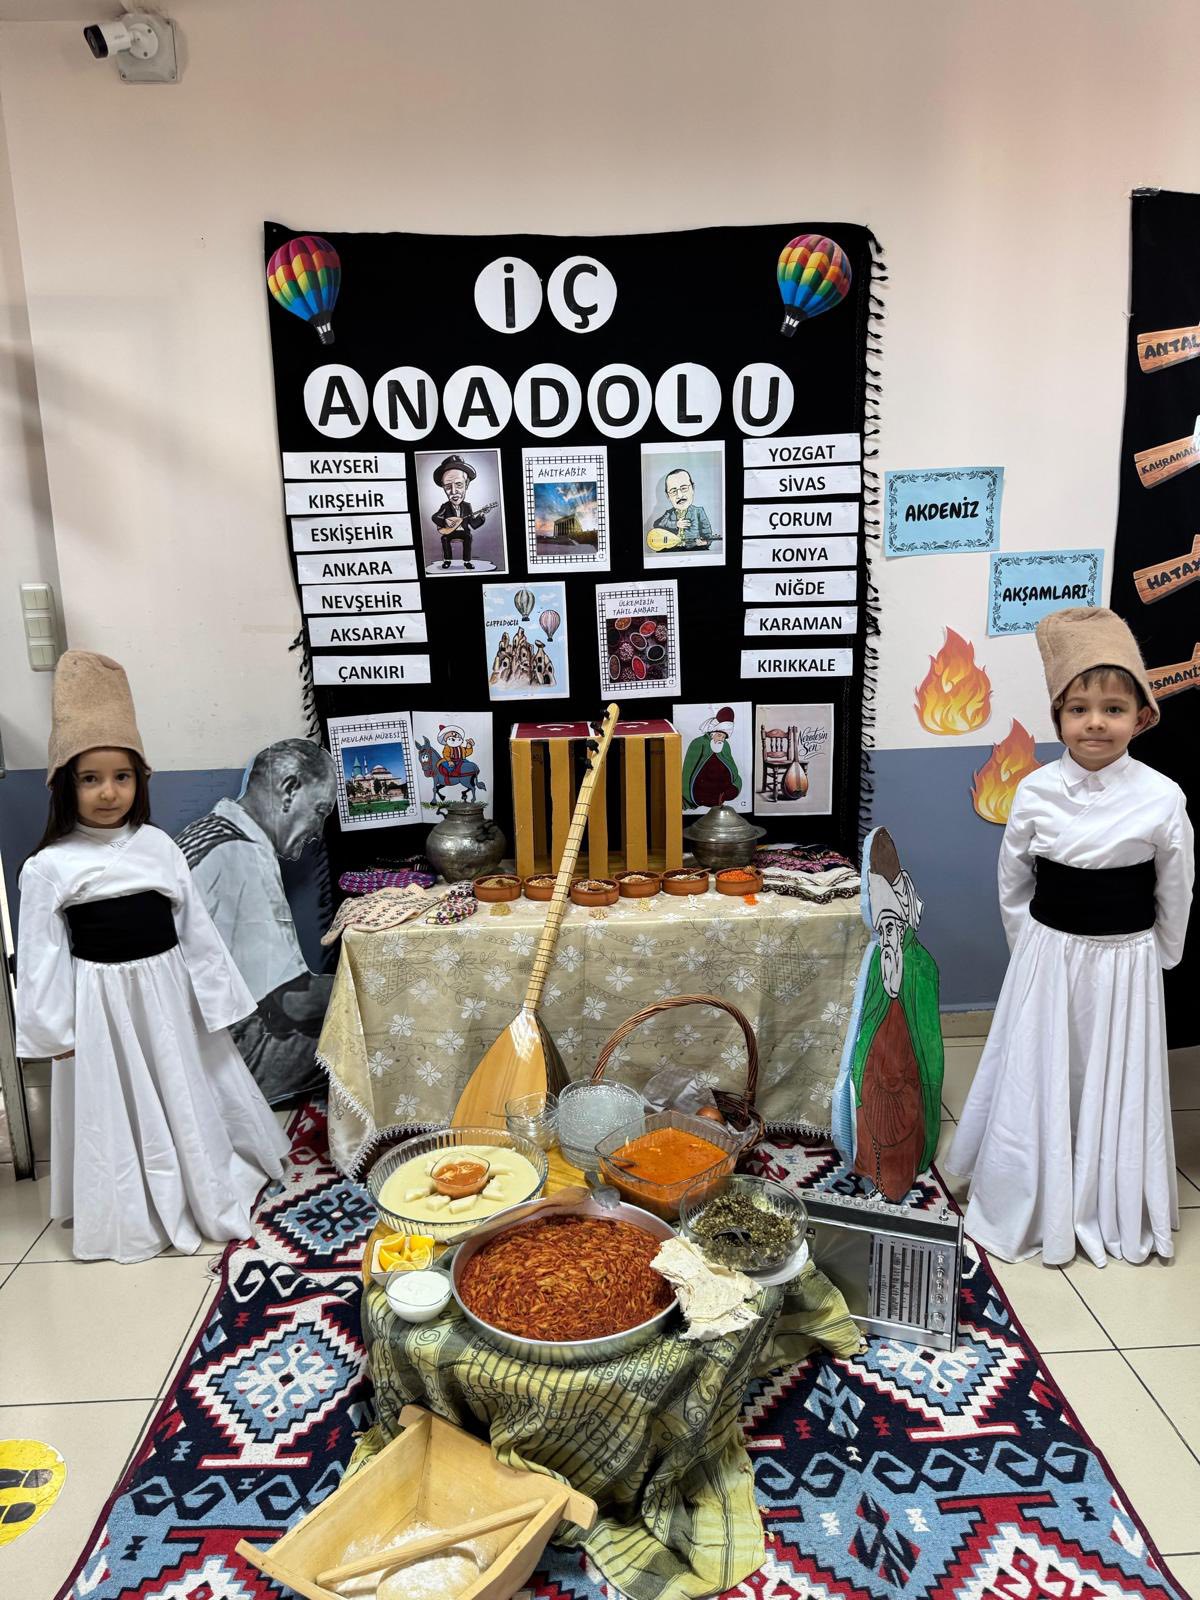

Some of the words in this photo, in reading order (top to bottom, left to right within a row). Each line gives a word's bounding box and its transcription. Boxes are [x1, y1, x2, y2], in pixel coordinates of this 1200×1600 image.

[503, 262, 598, 329] İÇ
[1144, 333, 1200, 359] ANTAL
[318, 373, 780, 430] ANADOLU
[768, 445, 836, 462] YOZGAT
[310, 456, 379, 474] KAYSERİ
[538, 466, 587, 477] ANITKABİR
[779, 475, 826, 492] SİVAS
[308, 490, 385, 511] KIRŞEHİR
[905, 496, 979, 522] AKDENİZ
[768, 512, 832, 530] ÇORUM
[311, 522, 393, 544] ESKİŞEHİR
[772, 547, 829, 562] KONYA
[322, 561, 393, 577] ANKARA
[775, 578, 825, 596] NİĞDE
[1002, 584, 1088, 606] AKŞAMLARI
[322, 591, 403, 611] NEVŞEHİR
[759, 616, 842, 631] KARAMAN
[330, 626, 406, 642] AKSARAY
[338, 665, 405, 682] ÇANKIRI
[757, 658, 836, 673] KIRIKKALE
[1149, 664, 1200, 690] SMANİ
